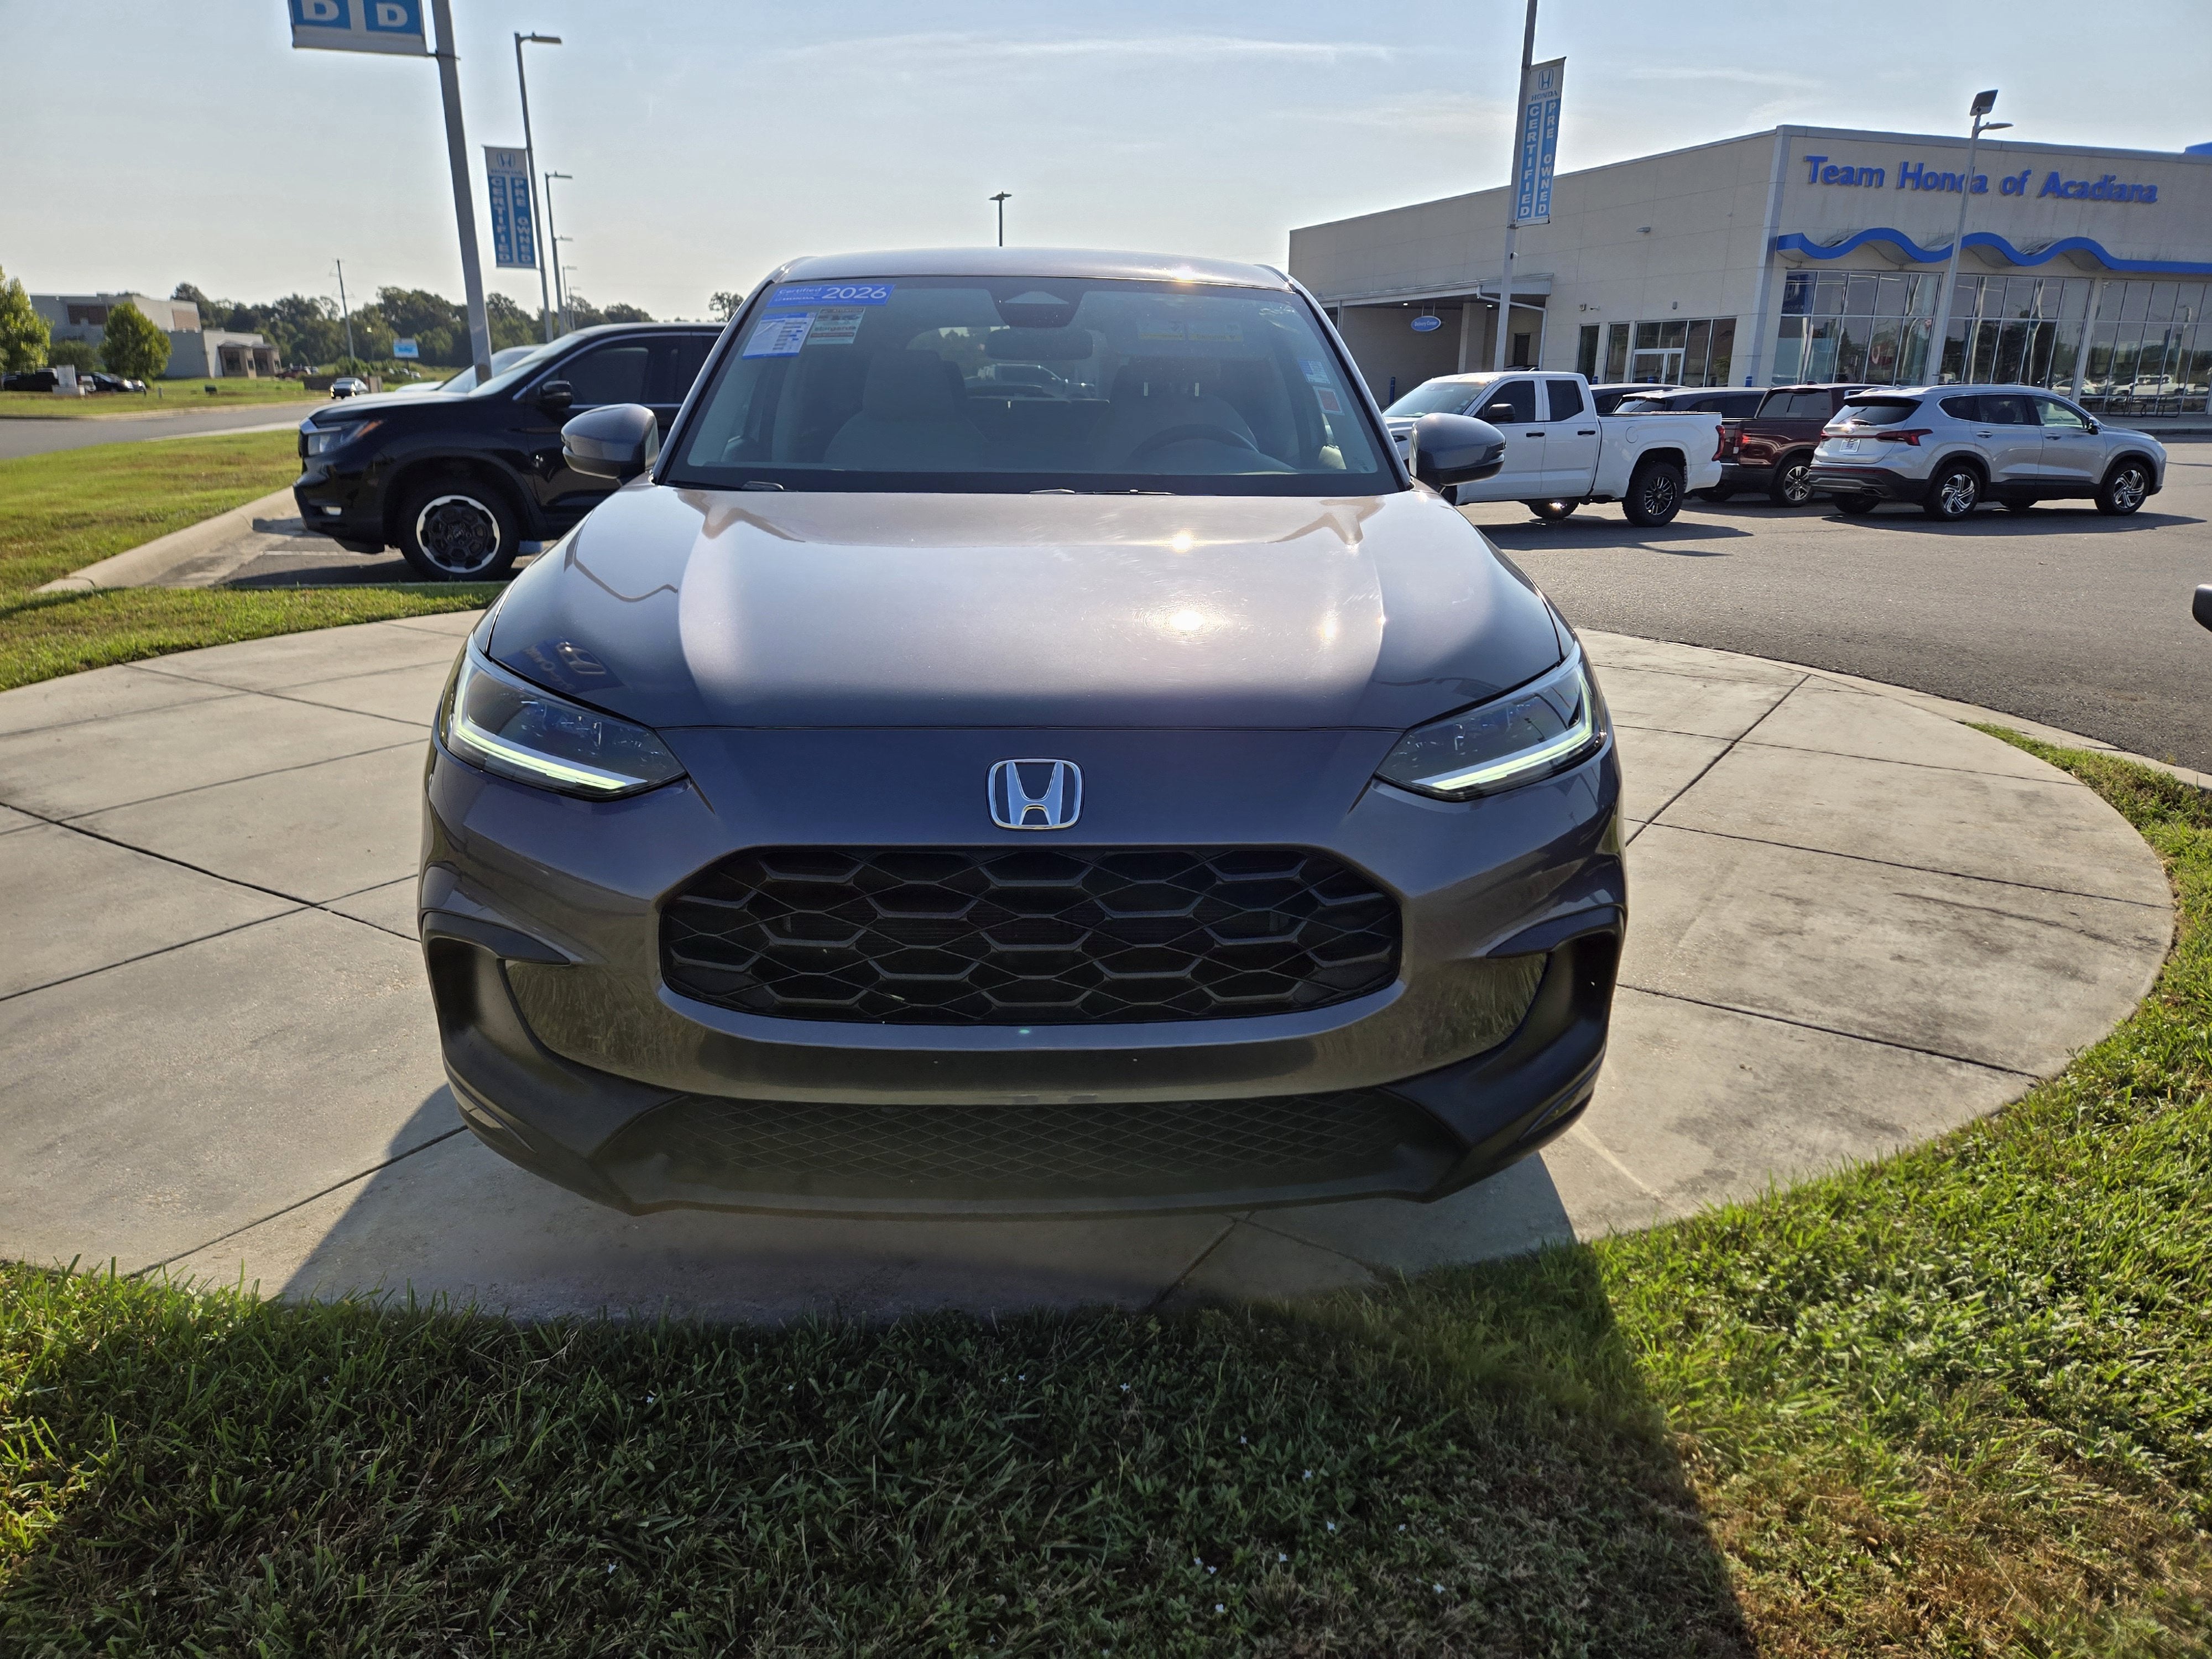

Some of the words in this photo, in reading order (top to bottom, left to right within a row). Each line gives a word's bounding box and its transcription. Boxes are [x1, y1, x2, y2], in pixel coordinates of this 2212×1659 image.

[1531, 90, 1558, 101] HONDA
[1546, 101, 1557, 139] PRE
[1521, 106, 1540, 216] CERTIFIED
[1538, 154, 1552, 214] OWNED
[1804, 155, 1885, 187] Team
[2000, 169, 2032, 196] of
[2036, 171, 2158, 204] Acadiana
[491, 178, 510, 261] CERTIFIED
[517, 216, 531, 262] OWNED
[822, 287, 886, 299] 2026
